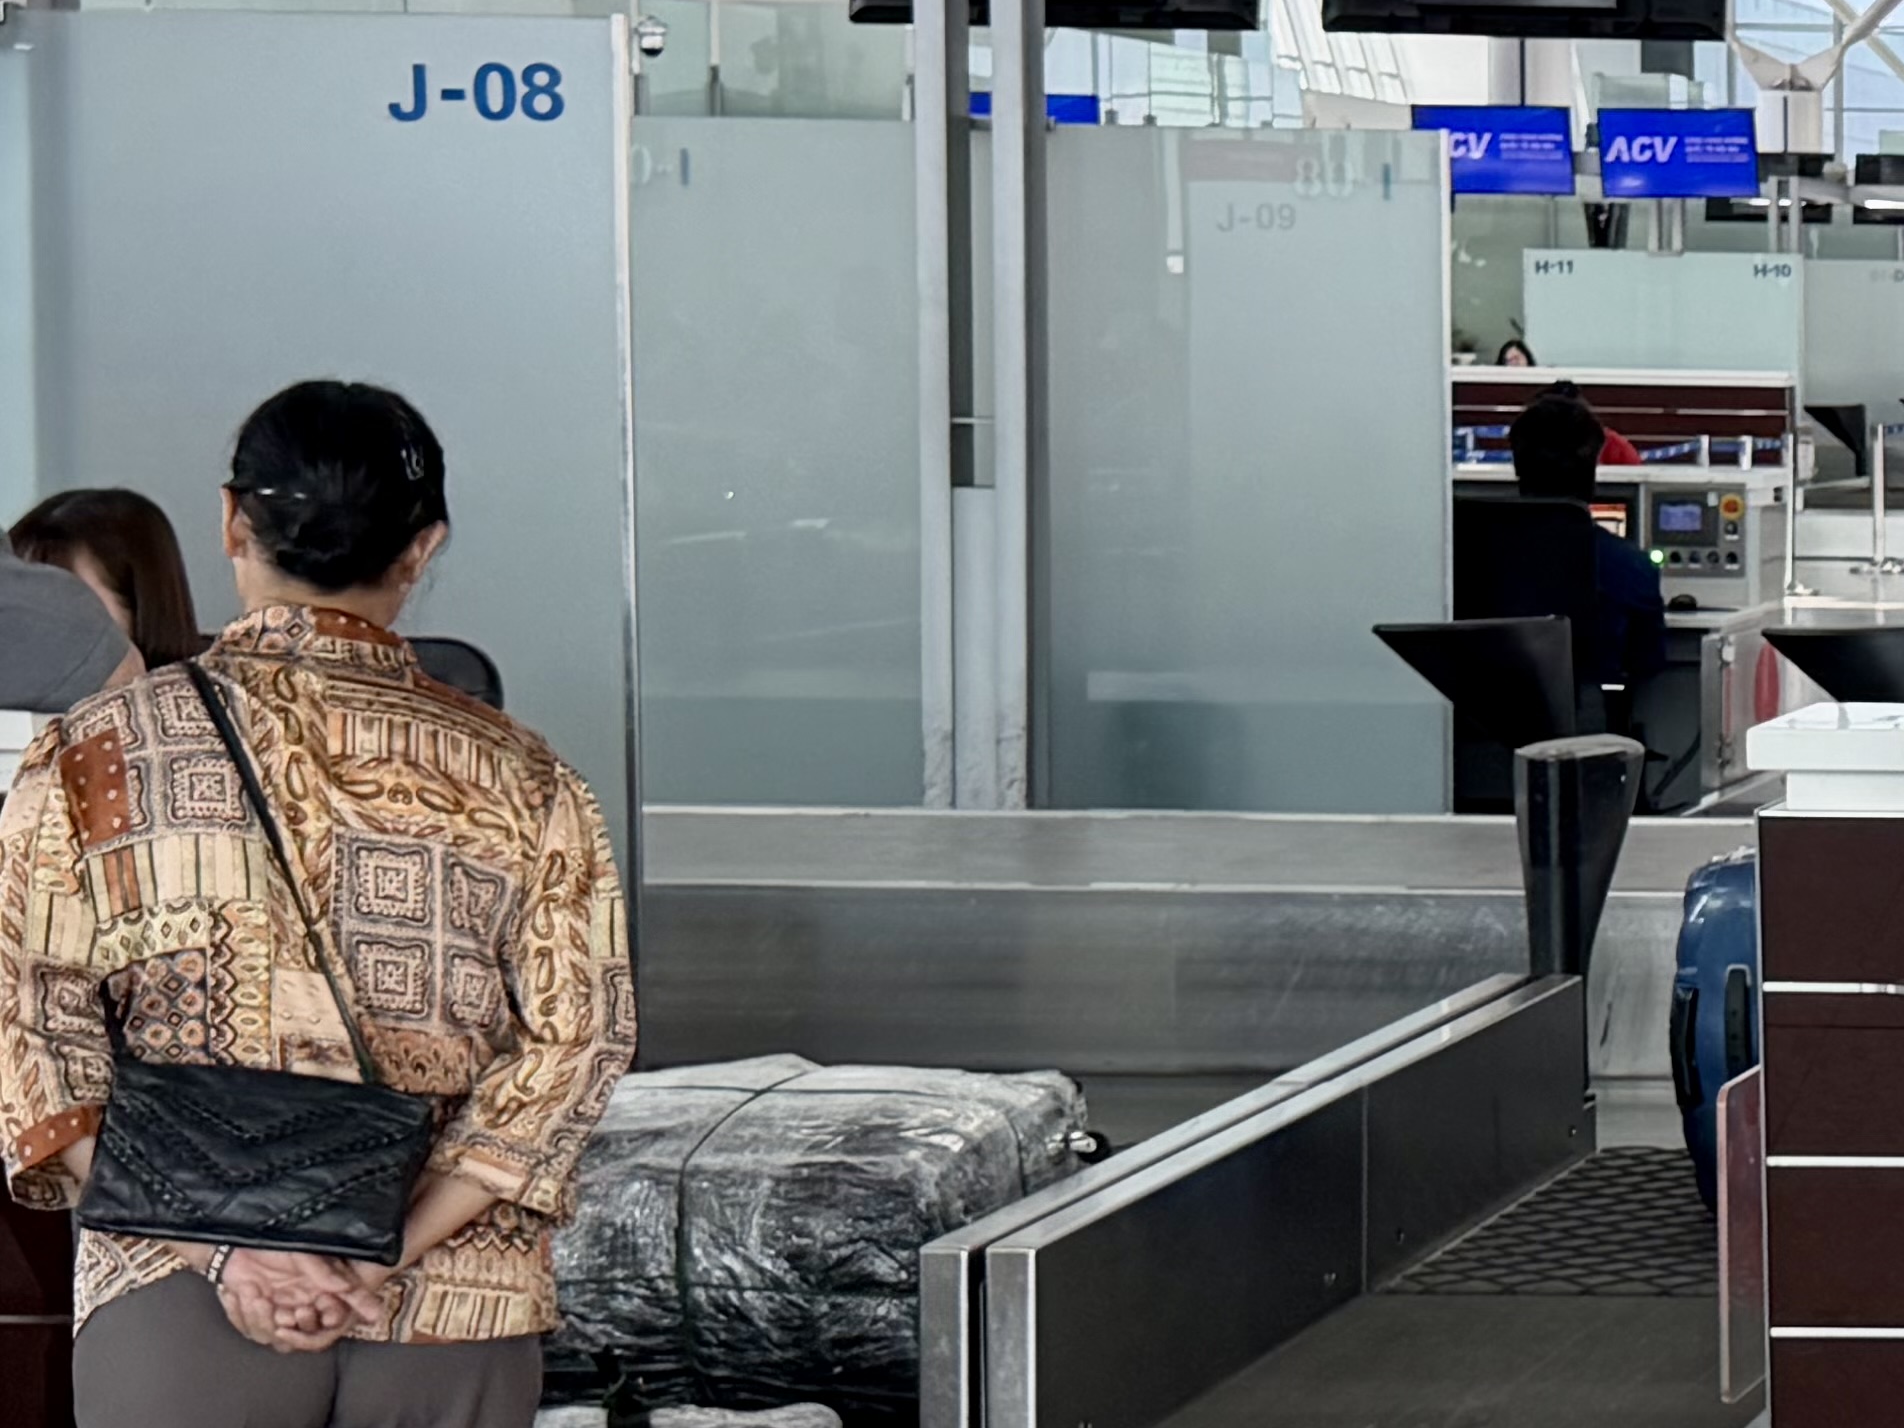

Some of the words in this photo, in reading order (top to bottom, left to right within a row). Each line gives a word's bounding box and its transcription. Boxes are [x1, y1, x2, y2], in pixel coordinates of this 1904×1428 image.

[388, 62, 565, 122] J-08
[1449, 132, 1492, 159] CV
[1605, 136, 1678, 163] ACV
[1216, 203, 1297, 232] J-09
[1535, 261, 1574, 275] H-11
